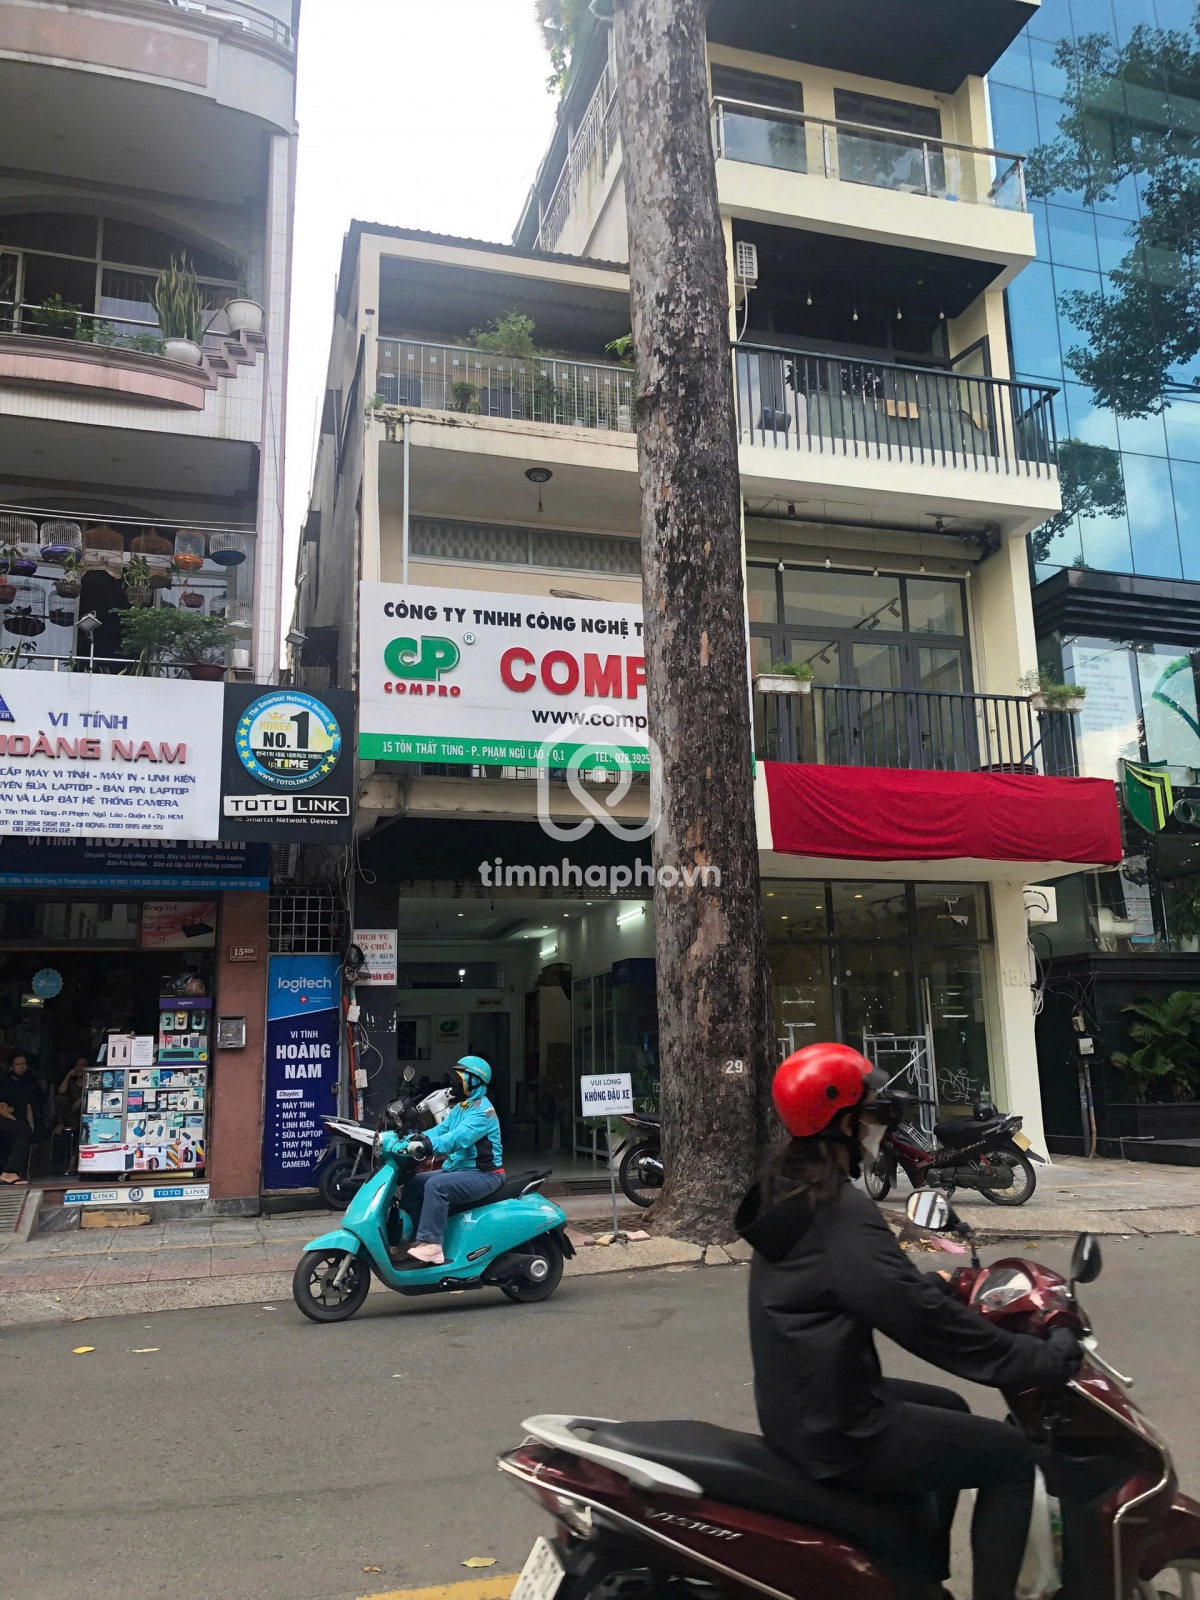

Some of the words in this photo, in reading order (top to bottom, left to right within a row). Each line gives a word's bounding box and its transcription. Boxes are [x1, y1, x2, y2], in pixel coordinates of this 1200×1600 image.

[384, 600, 437, 621] CÔNG
[443, 607, 466, 623] TY
[473, 609, 521, 628] TNHH
[526, 611, 576, 631] CÔNG
[581, 618, 629, 640] NGHỆ
[384, 682, 461, 697] COMPRO
[248, 707, 260, 718] The
[258, 695, 286, 709] Smartest
[286, 695, 313, 707] Network
[311, 703, 331, 723] Devices
[48, 711, 68, 727] VI
[79, 711, 128, 730] TÍNH
[259, 721, 293, 732] KOREA
[263, 731, 291, 749] NO.
[290, 711, 310, 749] 1
[111, 739, 187, 764] NAM
[383, 741, 393, 753] 15
[395, 739, 412, 754] TÔN
[416, 740, 437, 755] THẤT
[441, 742, 464, 756] TÙNG
[471, 746, 480, 757] P.
[482, 746, 506, 760] PHẠM
[509, 747, 526, 759] NGŨ
[528, 747, 544, 760] LÃO
[552, 750, 564, 762] Q.1
[595, 751, 612, 763] TEL:
[268, 758, 309, 769] ipTIME
[25, 769, 49, 778] MÁY
[53, 770, 63, 778] VI
[67, 769, 90, 779] TÍNH
[100, 771, 123, 780] MÁY
[127, 773, 138, 781] IN
[148, 774, 170, 782] LINH
[173, 775, 196, 784] KIỆN
[257, 770, 321, 786] WWW.TOTOLINK.NET
[0, 780, 22, 790] YÊN
[52, 783, 93, 792] LAPTOP
[103, 784, 125, 793] BÁN
[129, 785, 146, 794] PIN
[149, 786, 189, 795] LAPTOP
[16, 794, 29, 802] VÀ
[82, 796, 96, 805] HỆ
[137, 799, 179, 807] CAMERA
[310, 817, 338, 825] Devices
[357, 934, 377, 942] DỊCH
[278, 977, 332, 993] logitech
[290, 1031, 298, 1039] VI
[300, 1029, 318, 1038] TÍNH
[276, 1042, 331, 1060] HOÀNG
[285, 1064, 322, 1079] NAM
[726, 1060, 743, 1073] 29
[584, 1088, 606, 1102] KHÔNG
[607, 1087, 621, 1102] ĐẬU
[621, 1089, 630, 1099] XE
[282, 1101, 298, 1109] MÁY
[299, 1100, 315, 1109] TÍNH
[282, 1111, 298, 1119] MÁY
[299, 1120, 315, 1129] KIỆN
[297, 1130, 323, 1138] LAPTOP
[282, 1160, 310, 1168] CAMERA
